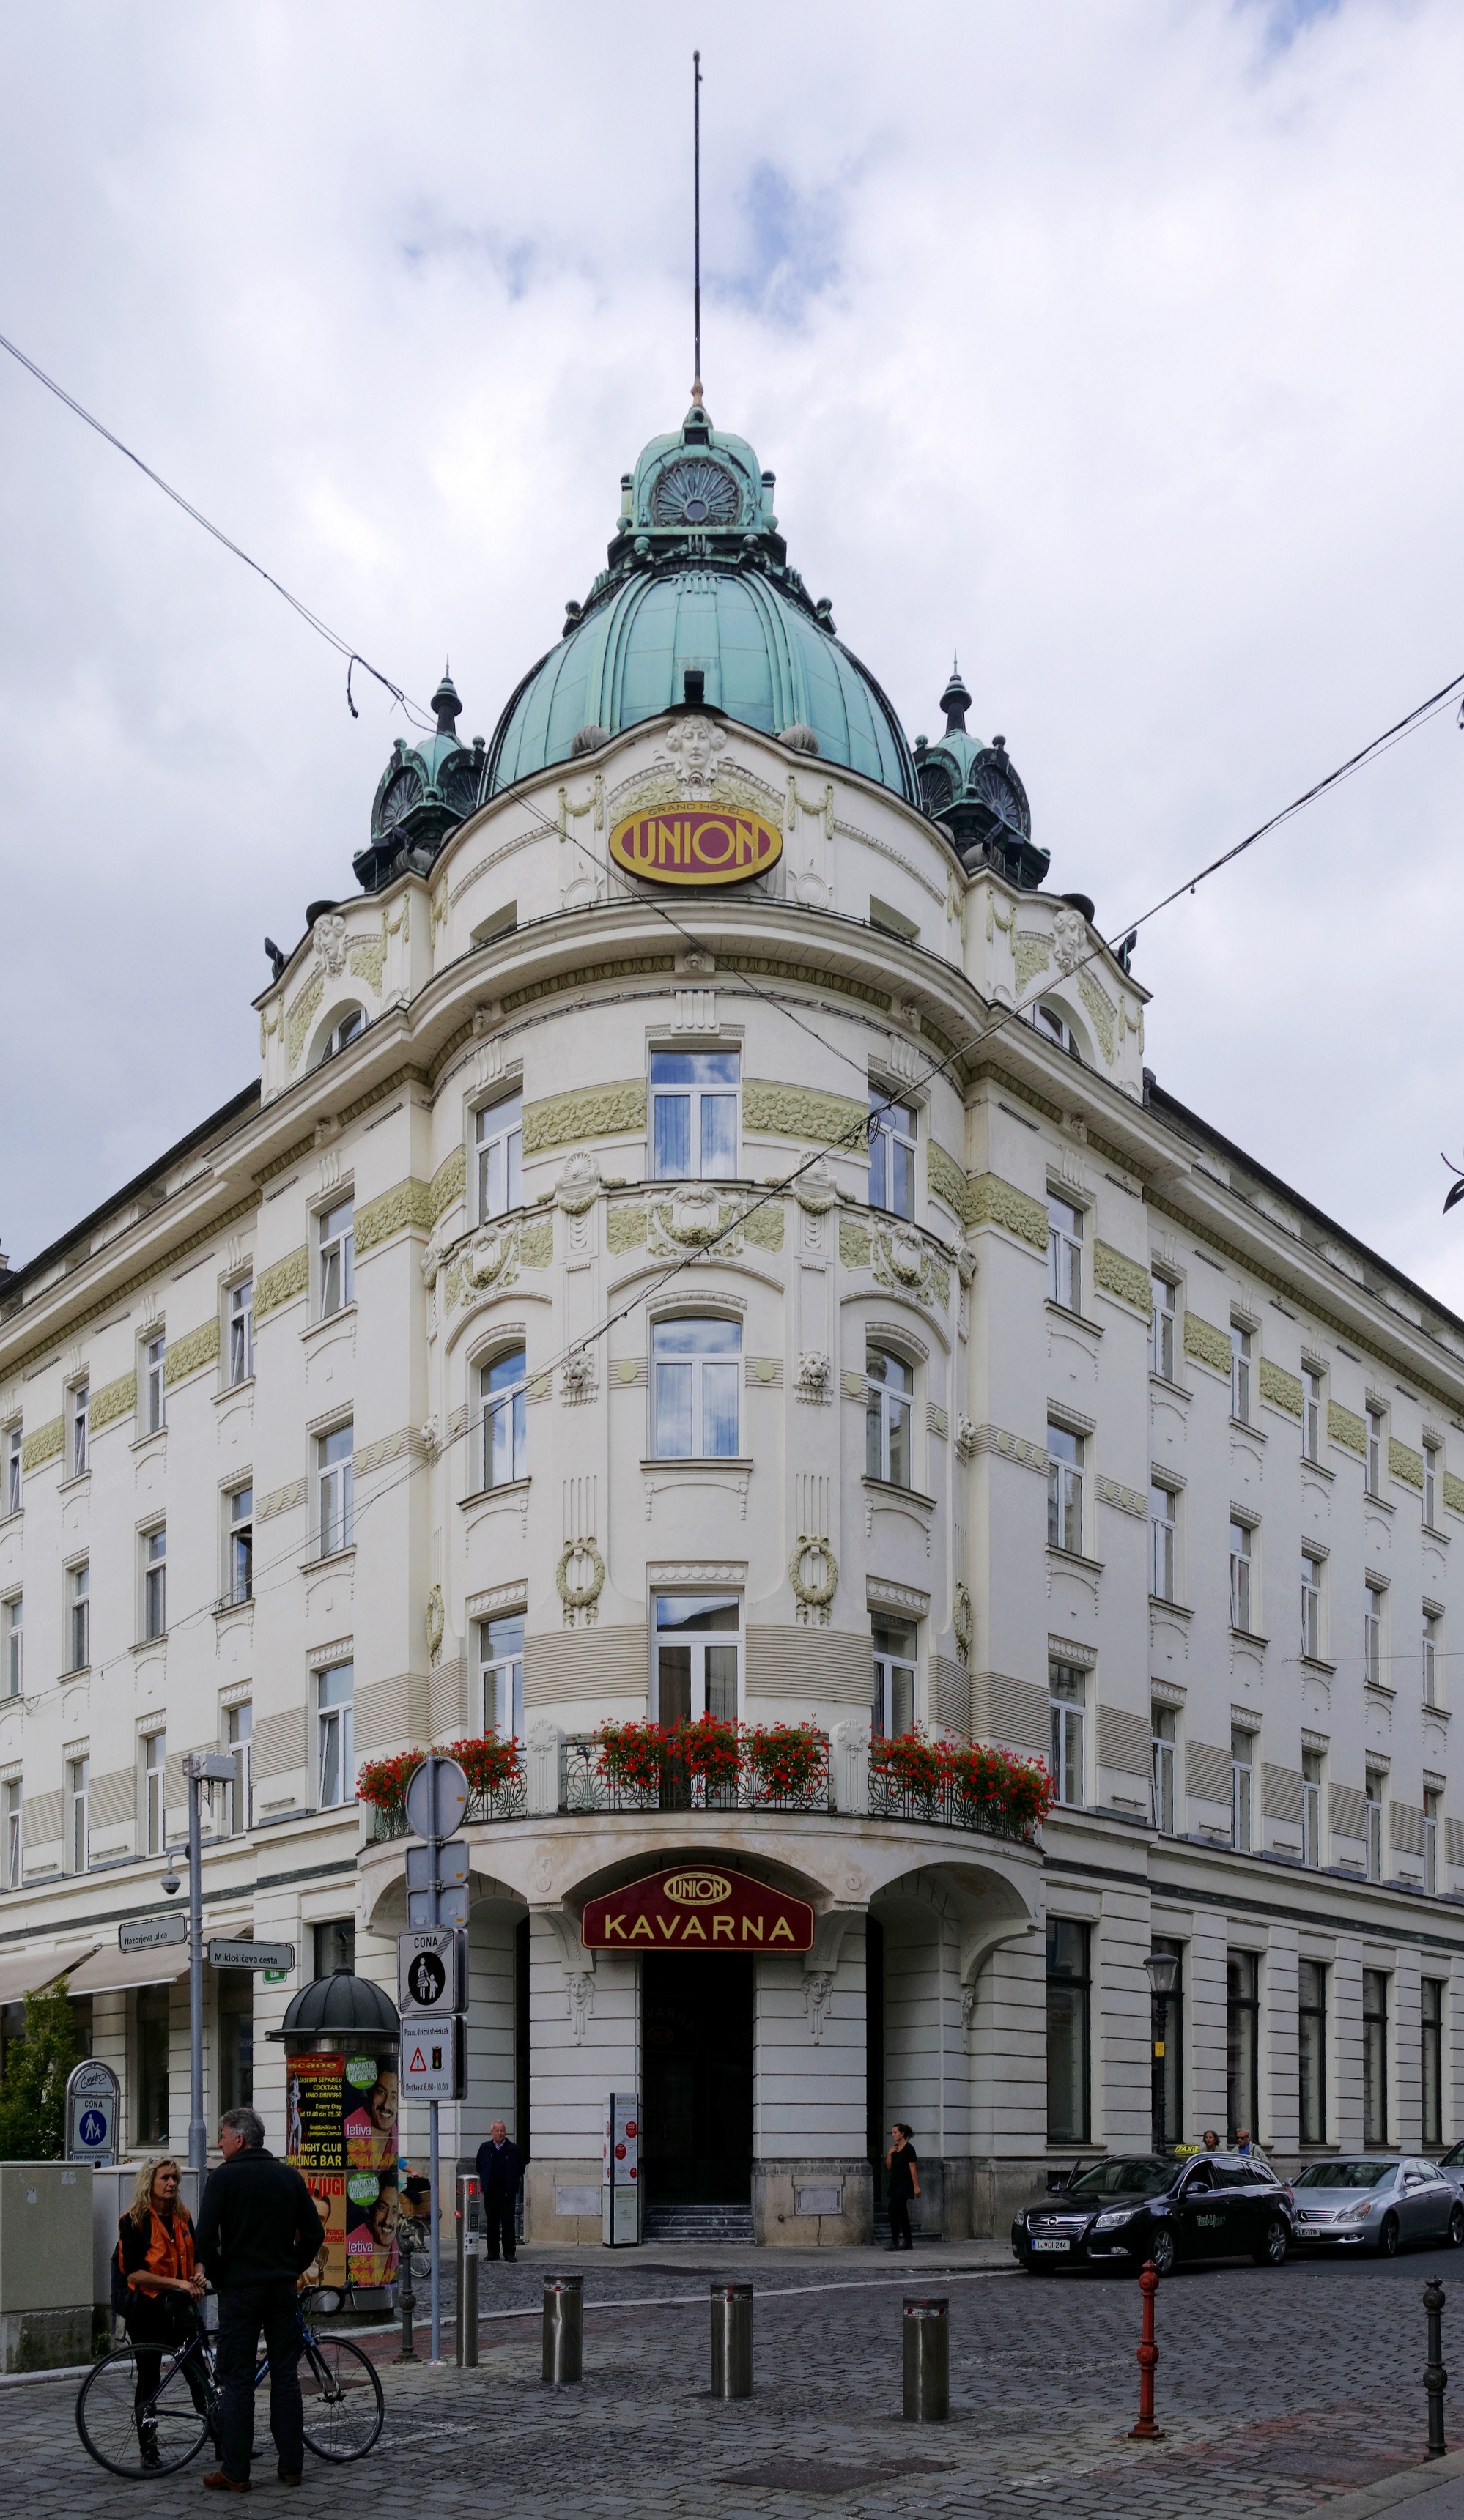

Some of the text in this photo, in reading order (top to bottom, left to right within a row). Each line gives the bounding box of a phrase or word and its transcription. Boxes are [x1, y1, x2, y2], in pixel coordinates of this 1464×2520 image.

[648, 803, 744, 818] GRAND HOTEL
[633, 820, 759, 865] UNION
[672, 1880, 723, 1899] UNION
[605, 1914, 795, 1941] KAVARNA
[125, 1931, 167, 1946] Nazorjeva ulica
[414, 1936, 438, 1949] CONA
[215, 1952, 278, 1965] Miklošičeva cesta
[347, 2124, 371, 2136] letiva
[300, 2143, 320, 2152] NIGHT
[322, 2143, 342, 2152] CLUB
[319, 2154, 342, 2167] BAR
[308, 2177, 344, 2199] V JUGI
[348, 2240, 374, 2253] letiva
